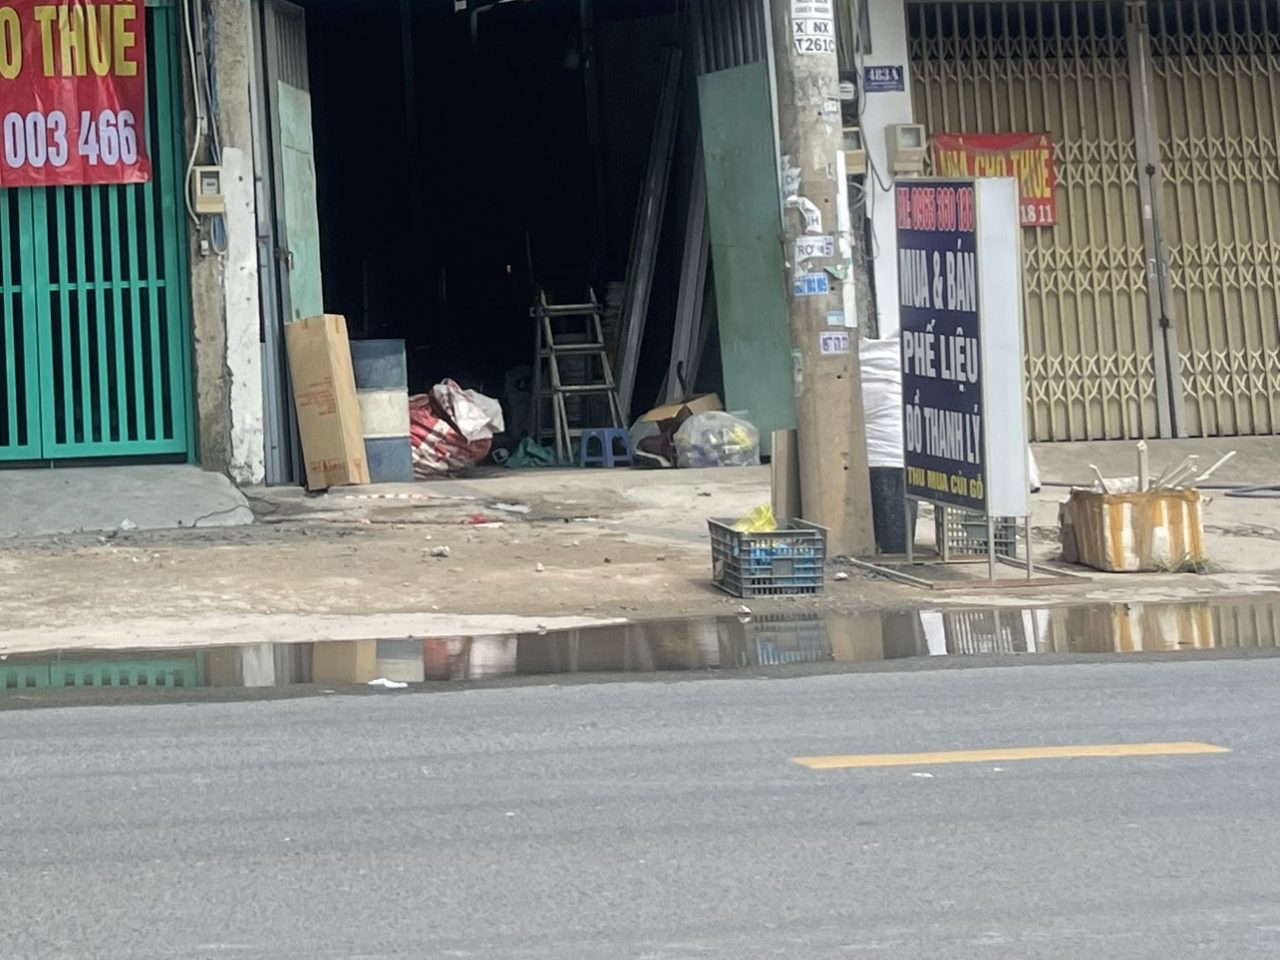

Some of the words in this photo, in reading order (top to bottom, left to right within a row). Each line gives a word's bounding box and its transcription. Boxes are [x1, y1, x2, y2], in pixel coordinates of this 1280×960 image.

[2, 110, 67, 169] 003
[77, 108, 138, 167] 466
[900, 248, 930, 308] MUA
[932, 250, 944, 310] &
[946, 238, 976, 312] BÁN
[903, 319, 936, 378] PHẾ
[940, 326, 978, 392] LIỆU
[924, 407, 964, 461] THANH
[966, 404, 980, 464] LÝ
[907, 466, 925, 487] THU
